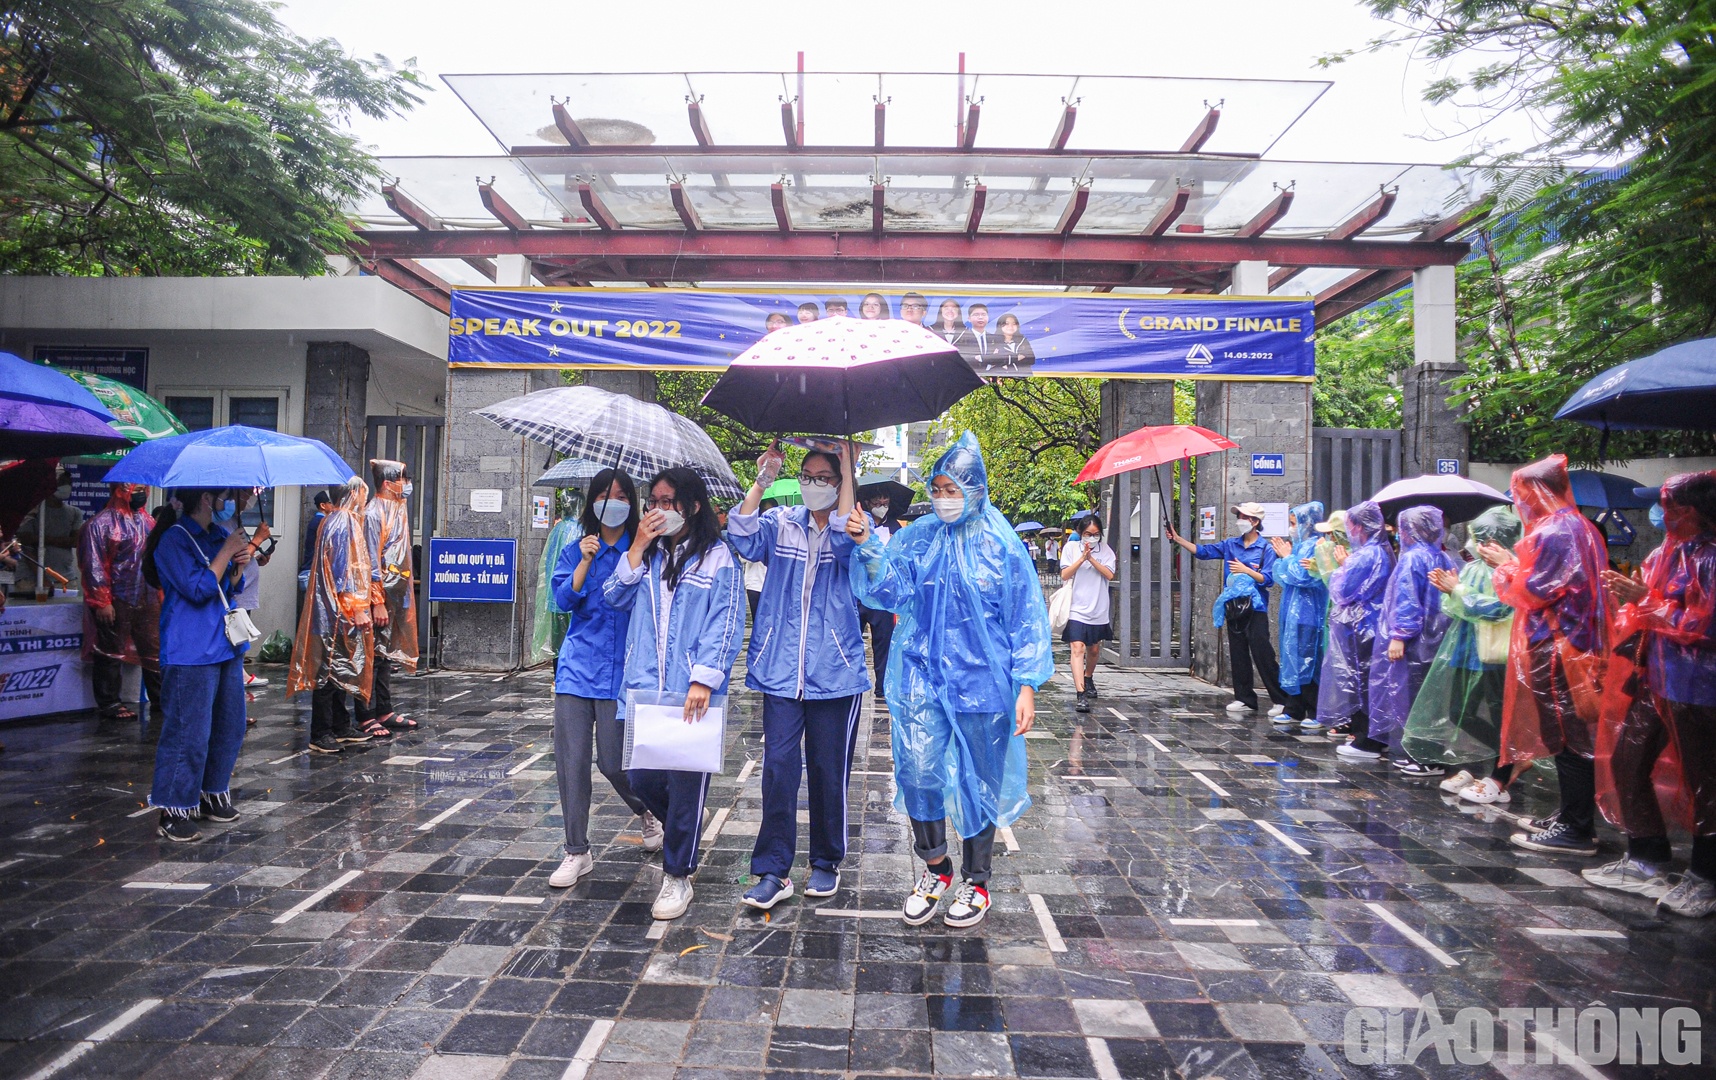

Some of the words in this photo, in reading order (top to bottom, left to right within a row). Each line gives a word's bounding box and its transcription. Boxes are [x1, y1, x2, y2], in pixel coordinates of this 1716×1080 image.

[449, 318, 542, 336] SPEAK
[549, 319, 609, 337] OUT
[615, 320, 682, 338] 2022
[1138, 316, 1219, 331] GRAND
[1224, 317, 1302, 333] FINALE
[1223, 351, 1274, 360] 14.05.2022
[1112, 455, 1142, 469] THACO
[1275, 459, 1282, 469] A
[1440, 461, 1456, 473] 35
[438, 551, 456, 564] CẢM
[457, 553, 468, 565] ƠN
[469, 552, 485, 566] QUÝ
[485, 554, 493, 568] VỊ
[494, 553, 505, 566] ĐÃ
[434, 569, 460, 583] XUỐNG
[460, 573, 471, 584] XE
[491, 572, 509, 585] MÁY
[18, 640, 42, 651] THI
[46, 637, 80, 649] 2022
[5, 668, 58, 692] 2022
